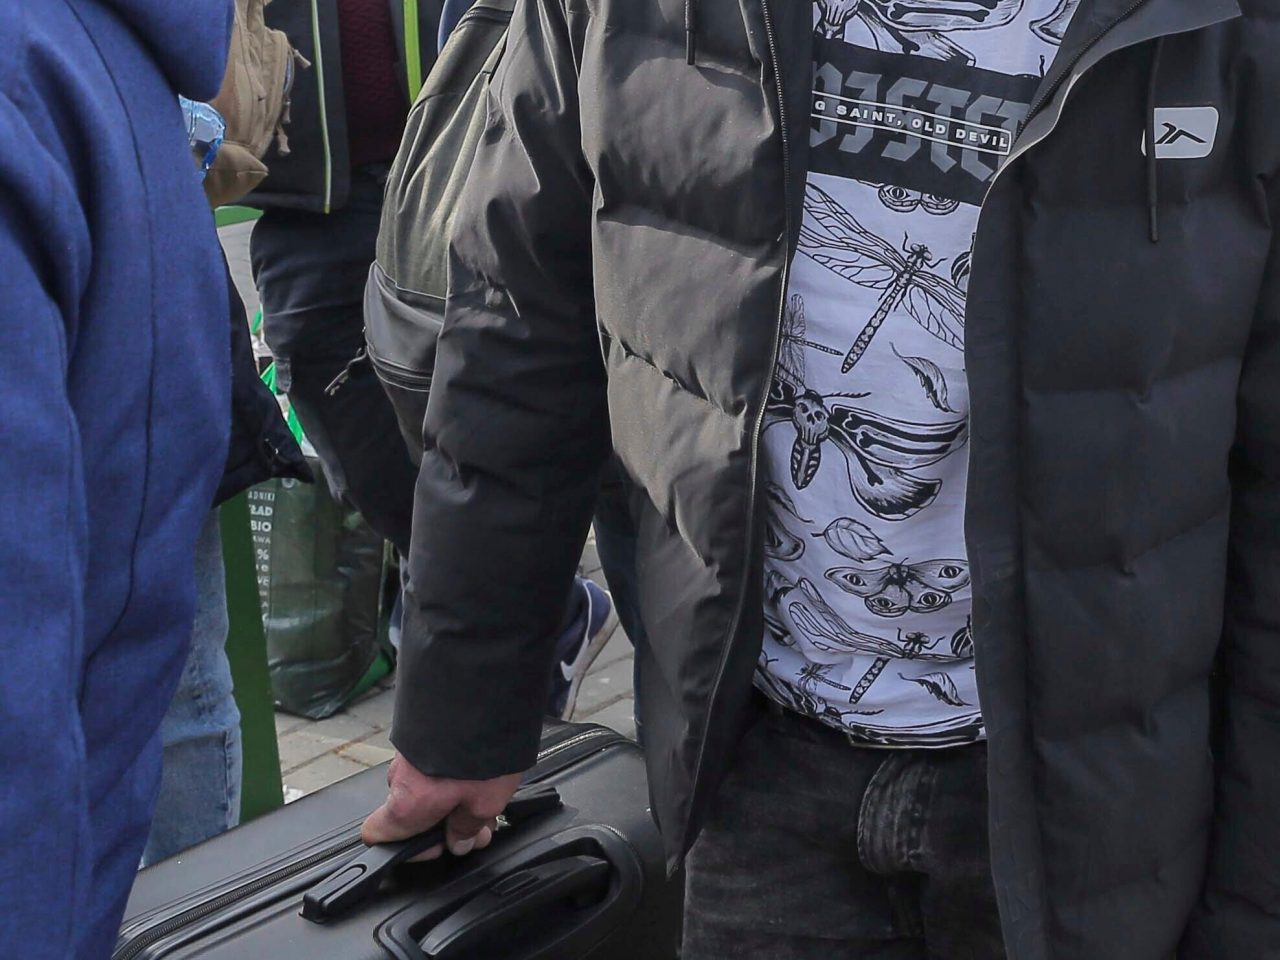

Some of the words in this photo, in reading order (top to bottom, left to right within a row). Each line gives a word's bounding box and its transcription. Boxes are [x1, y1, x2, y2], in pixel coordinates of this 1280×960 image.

[835, 104, 903, 127] SAINT,
[911, 117, 947, 135] OLD
[955, 128, 1009, 148] DEVIL
[250, 519, 272, 532] BIO
